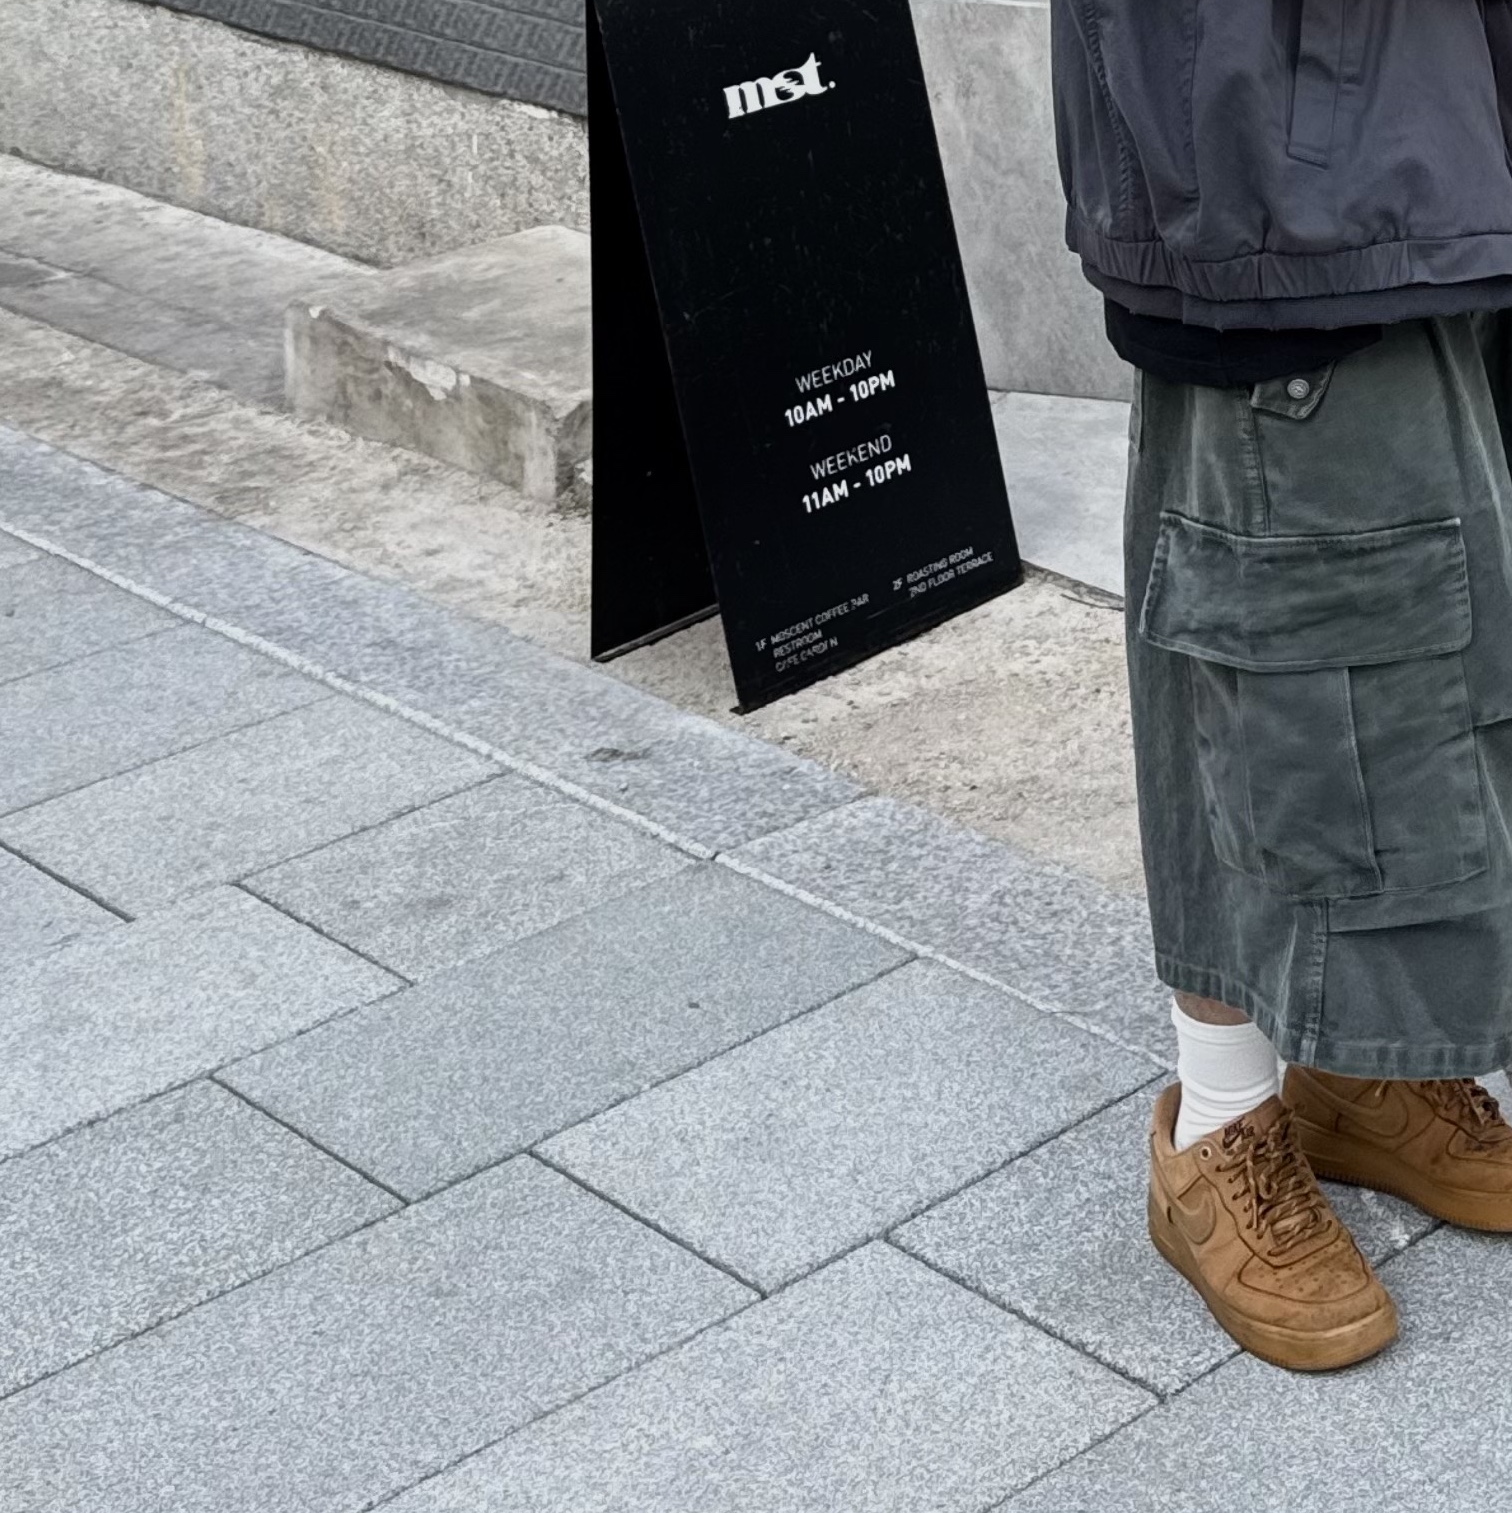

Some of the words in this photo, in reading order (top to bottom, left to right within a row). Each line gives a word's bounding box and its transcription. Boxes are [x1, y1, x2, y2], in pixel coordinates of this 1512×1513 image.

[795, 349, 872, 393] WEEKDAY
[784, 393, 833, 427] 10AM
[849, 369, 896, 402] 10PM
[810, 434, 893, 480] WEEKEND
[802, 479, 849, 514] 11AM
[865, 453, 912, 487] 10PM
[906, 557, 948, 584] ROASTING
[948, 546, 974, 565] ROOM
[814, 601, 849, 626] COFFEE
[773, 628, 823, 659] RESTROOM
